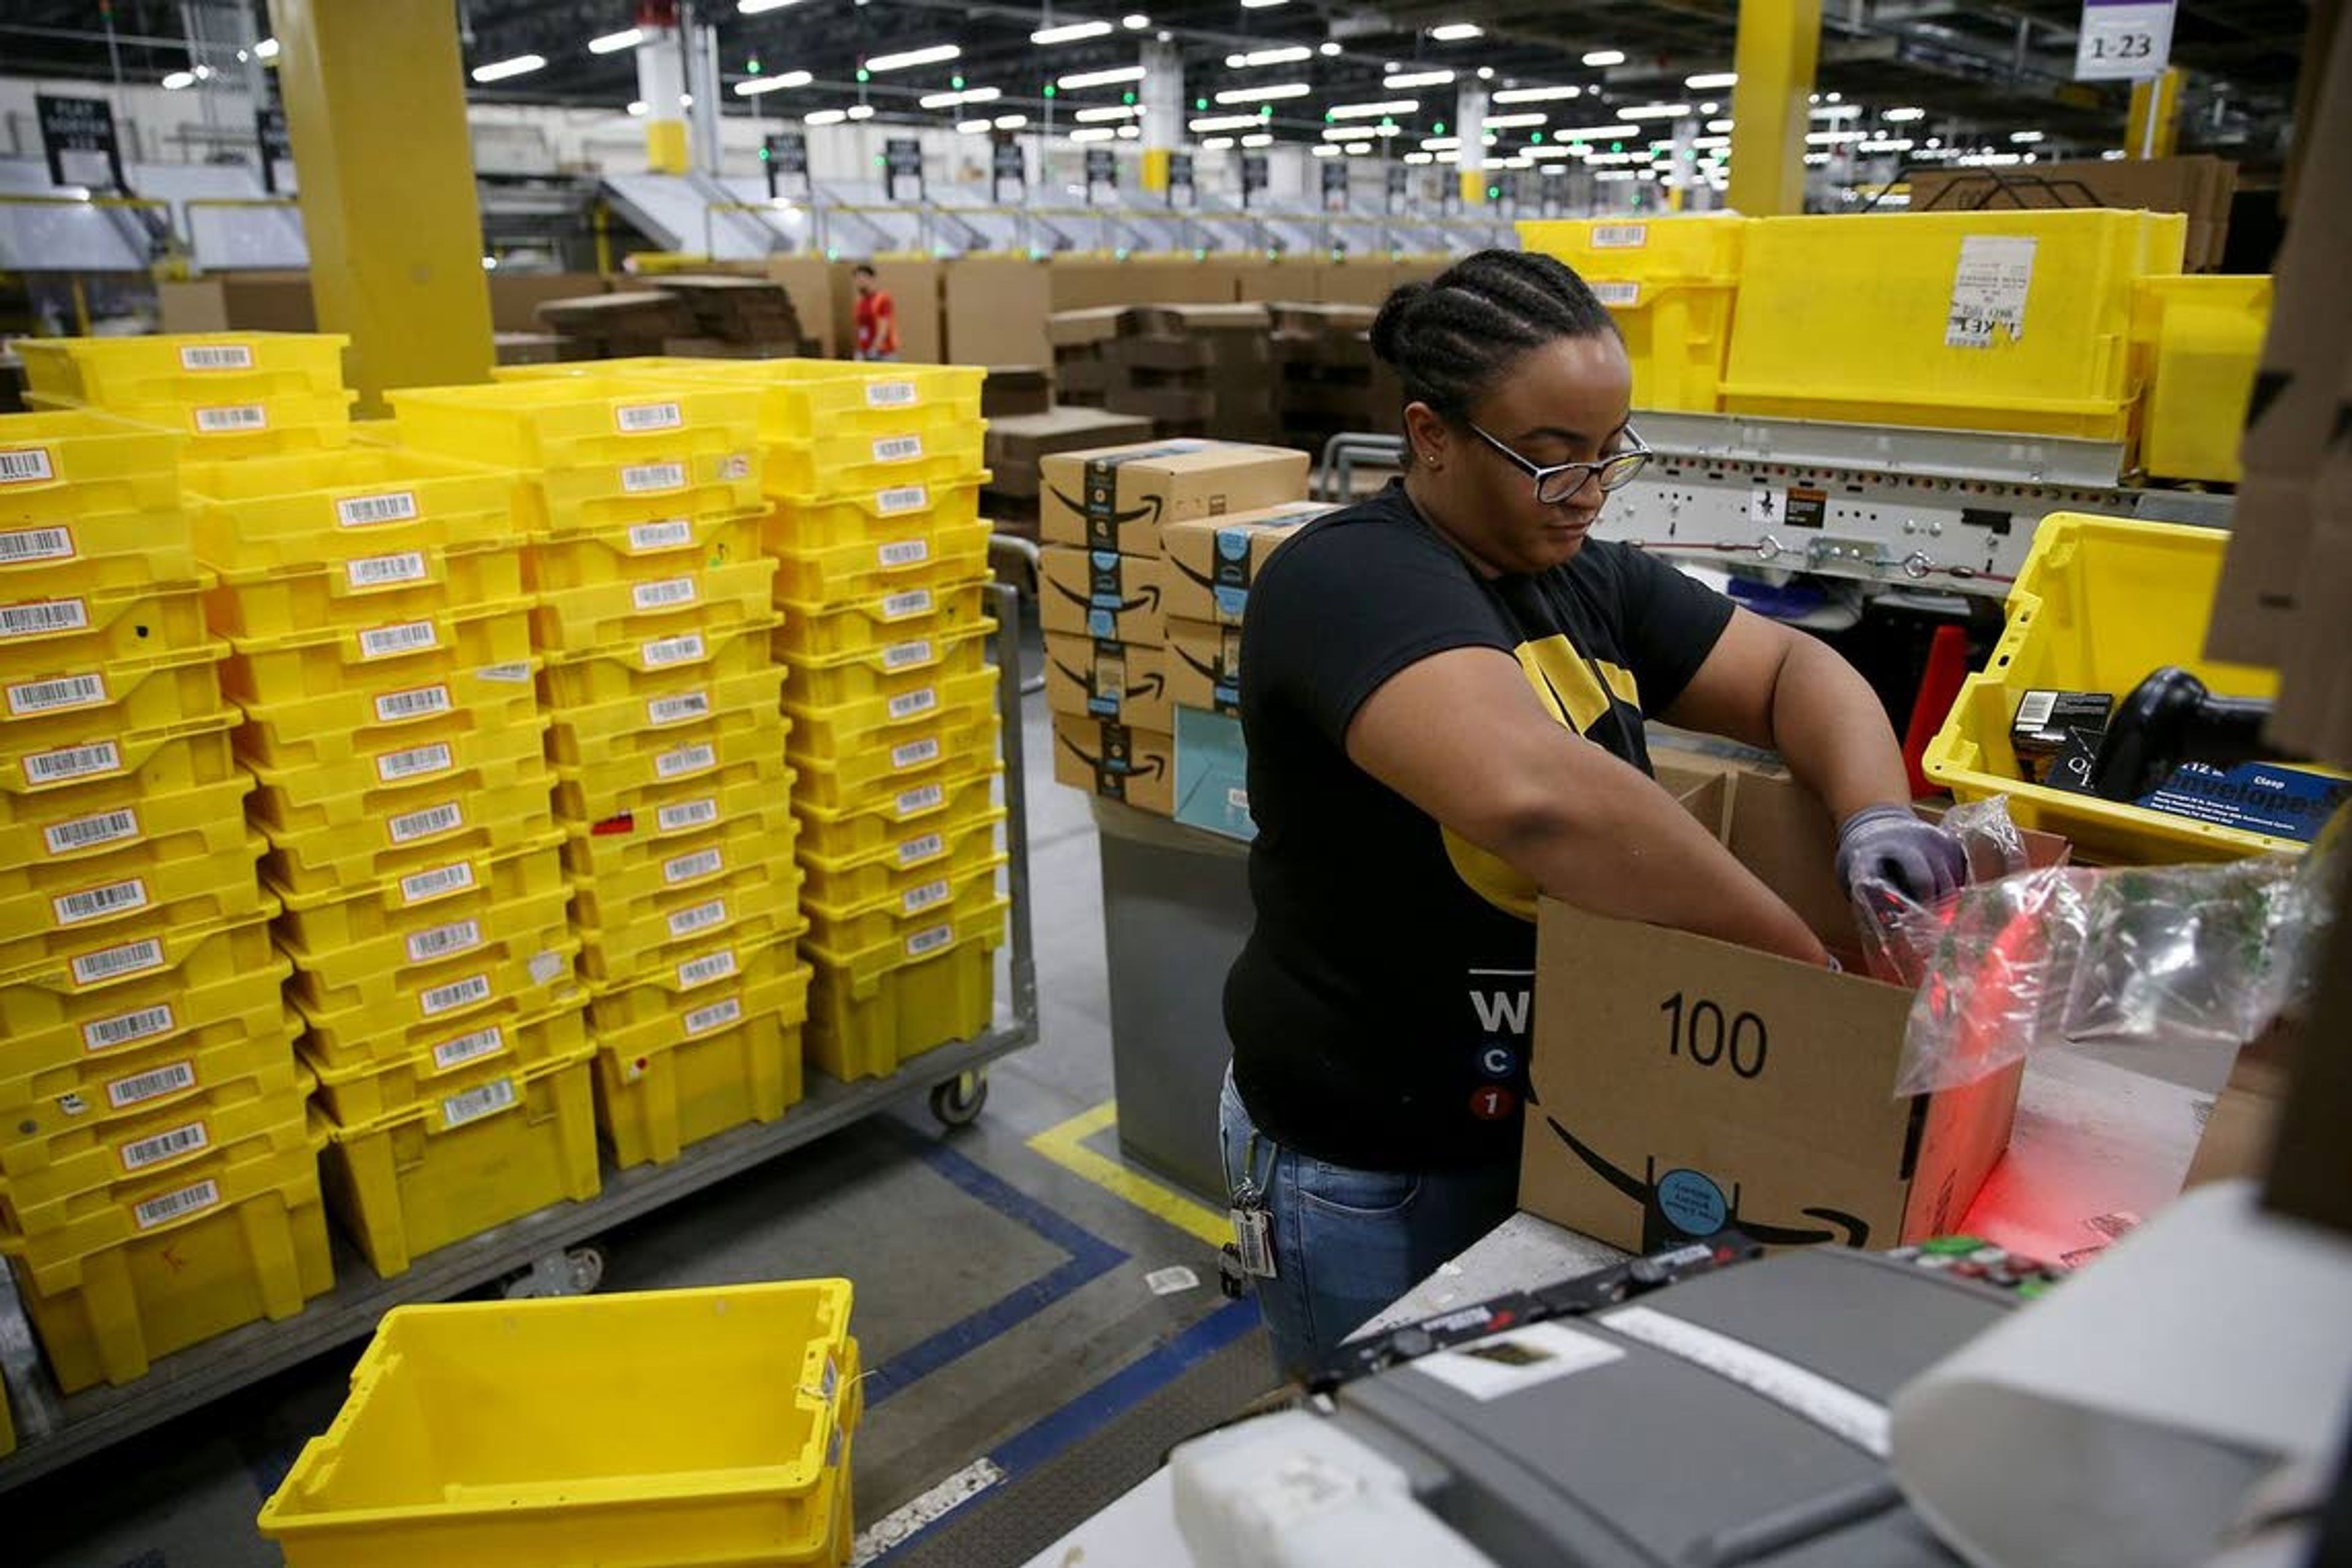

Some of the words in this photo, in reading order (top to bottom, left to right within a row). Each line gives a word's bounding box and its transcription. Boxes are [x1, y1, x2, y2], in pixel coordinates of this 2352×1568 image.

[2091, 34, 2151, 58] 1-23
[1660, 992, 1767, 1079] 100
[1483, 1049, 1508, 1072] C
[1485, 1093, 1498, 1114] 1
